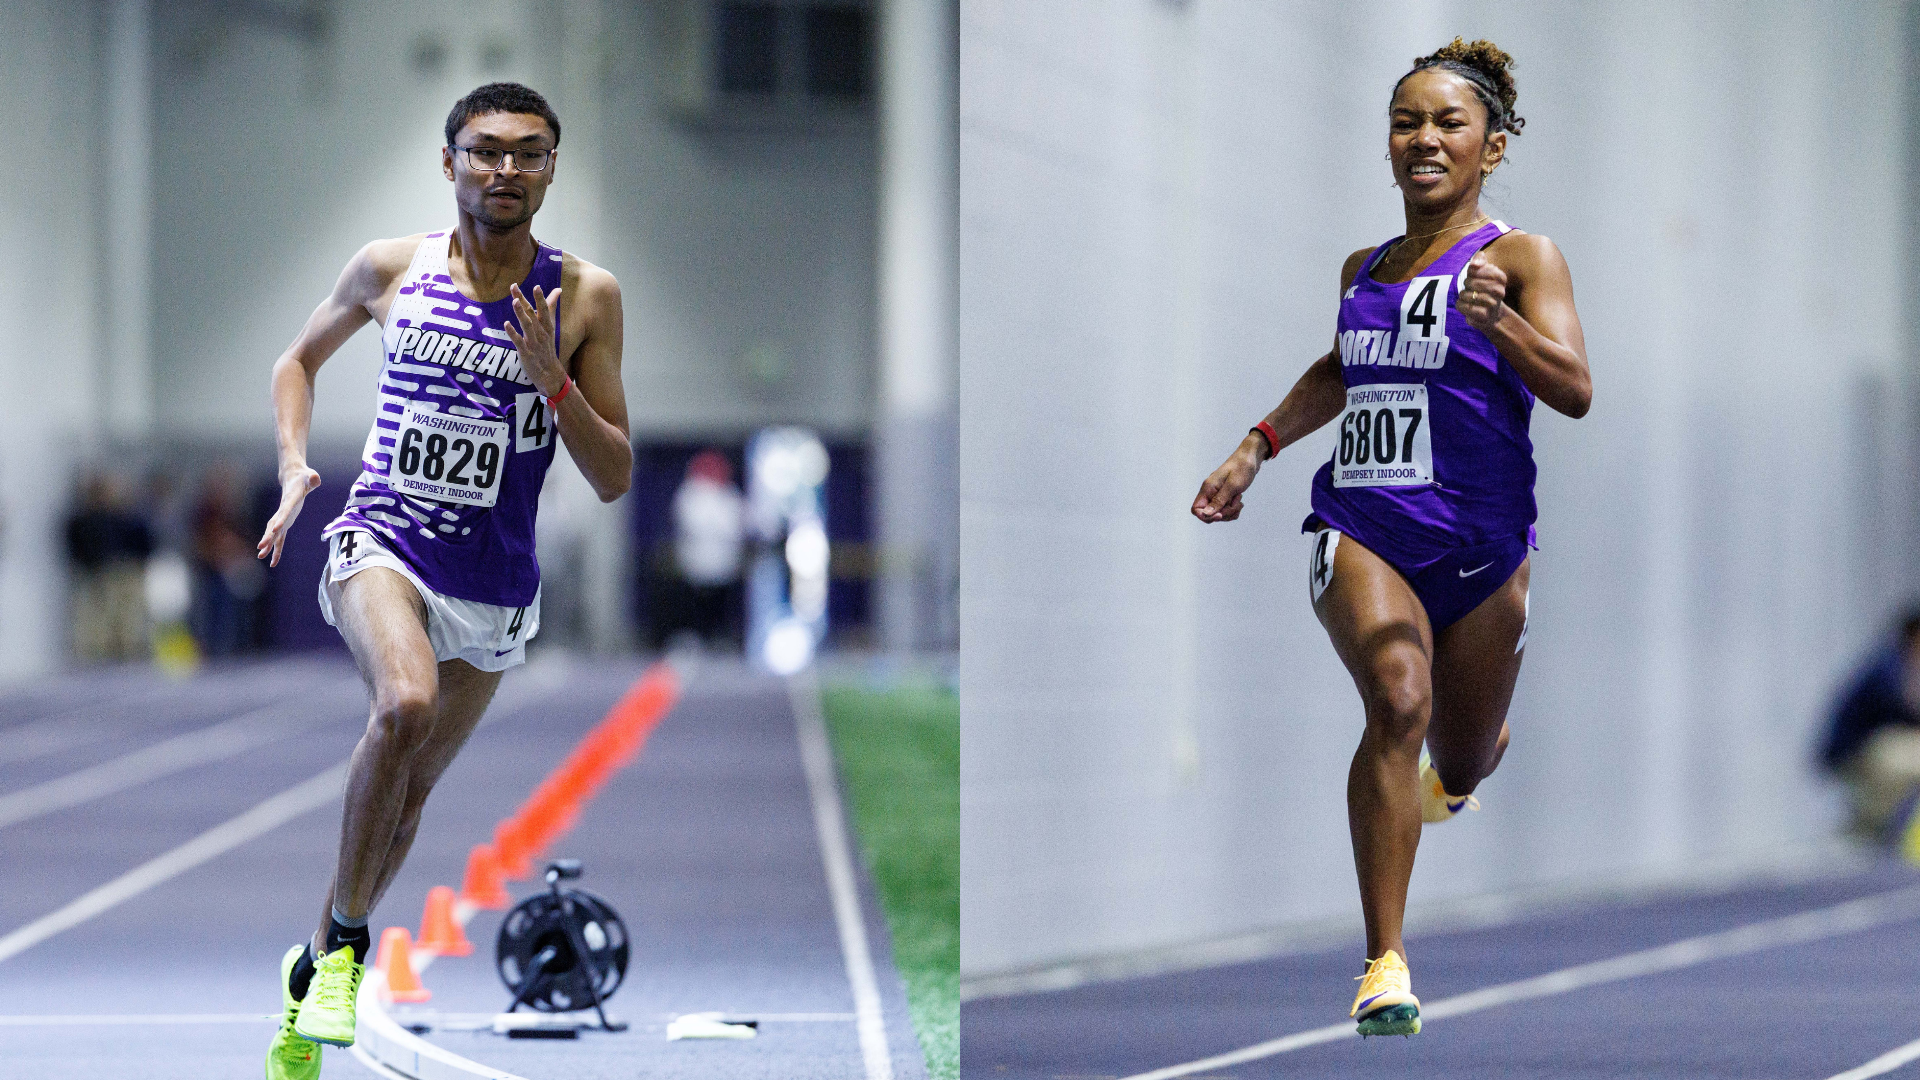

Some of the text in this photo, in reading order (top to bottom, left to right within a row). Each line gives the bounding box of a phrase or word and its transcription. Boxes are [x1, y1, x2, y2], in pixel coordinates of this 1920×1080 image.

[1406, 279, 1439, 338] 4
[1339, 329, 1450, 370] ORTLAND
[1351, 389, 1416, 406] WASHINGTON
[412, 412, 498, 438] WASHINGTON
[522, 395, 547, 447] 4
[1339, 407, 1422, 467] 6807
[398, 427, 500, 489] 6829
[1342, 468, 1417, 480] DEMPSEY INDOOR
[403, 478, 446, 495] DEMPSEY
[448, 488, 484, 501] INDOOR
[339, 531, 357, 558] 4
[1314, 530, 1330, 587] 4
[507, 606, 526, 642] 4
